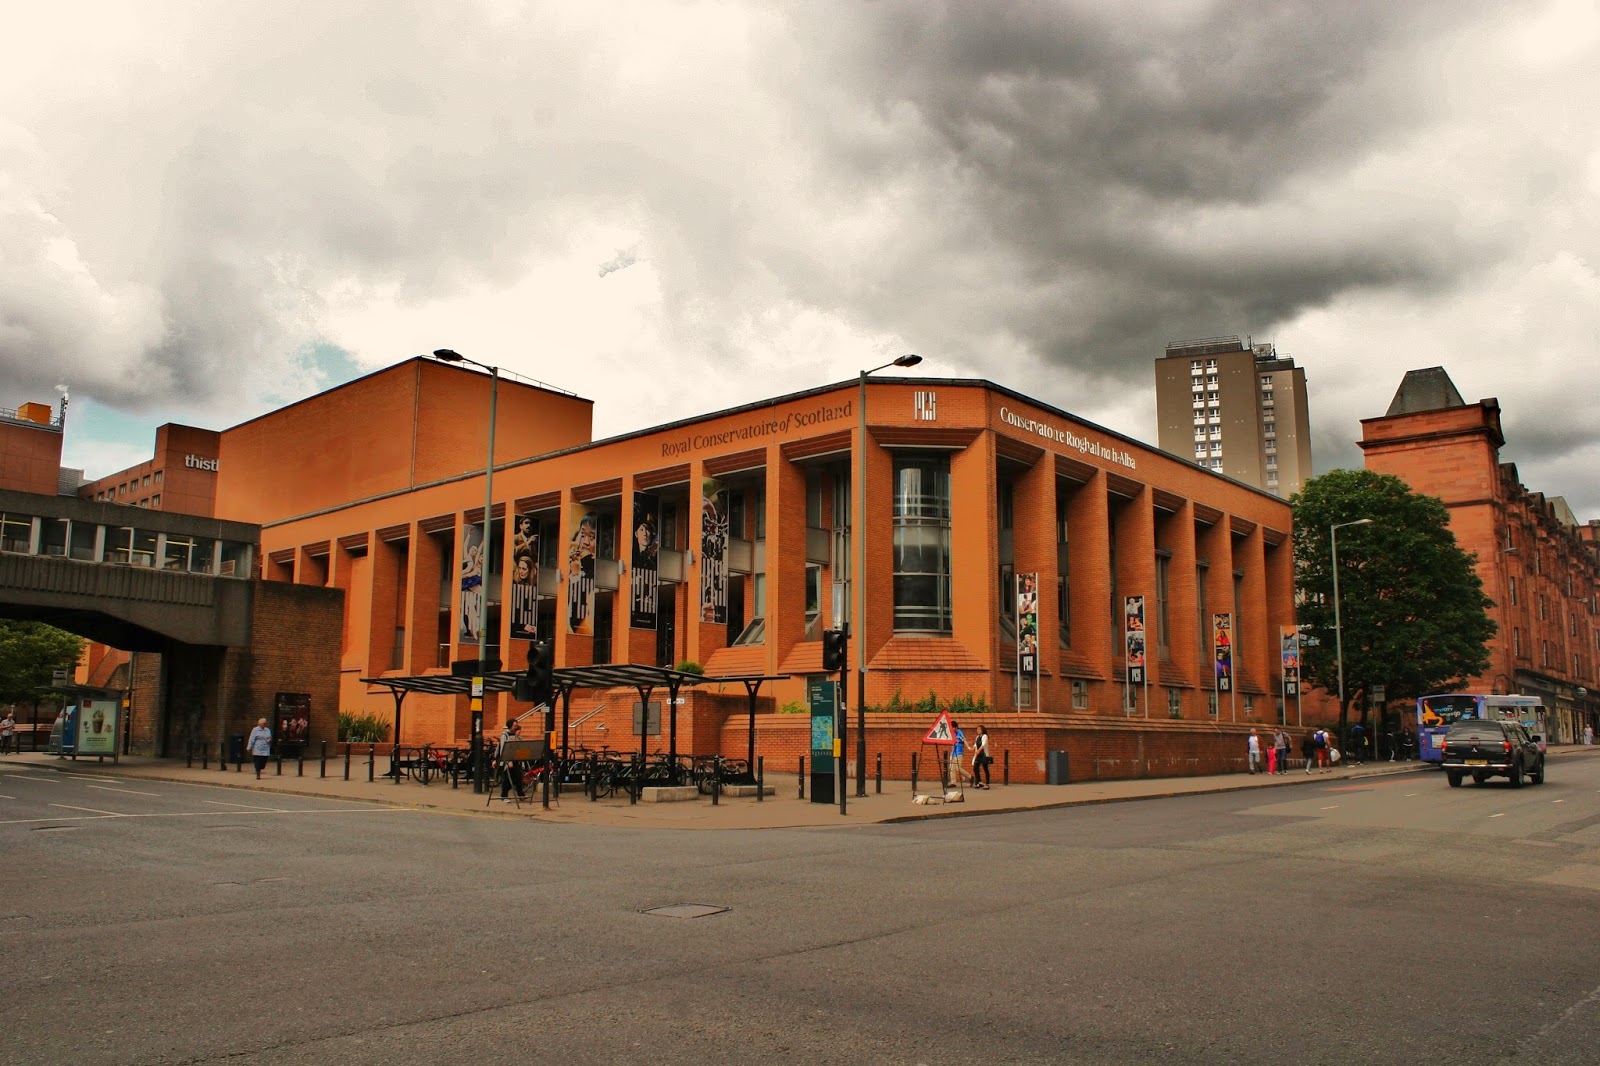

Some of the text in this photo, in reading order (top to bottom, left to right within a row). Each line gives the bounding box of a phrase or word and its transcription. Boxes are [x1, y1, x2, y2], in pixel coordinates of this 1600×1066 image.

[661, 400, 853, 458] Royal Conservatoire of Scotland
[1100, 447, 1111, 460] na
[1112, 447, 1136, 470] h-Alba
